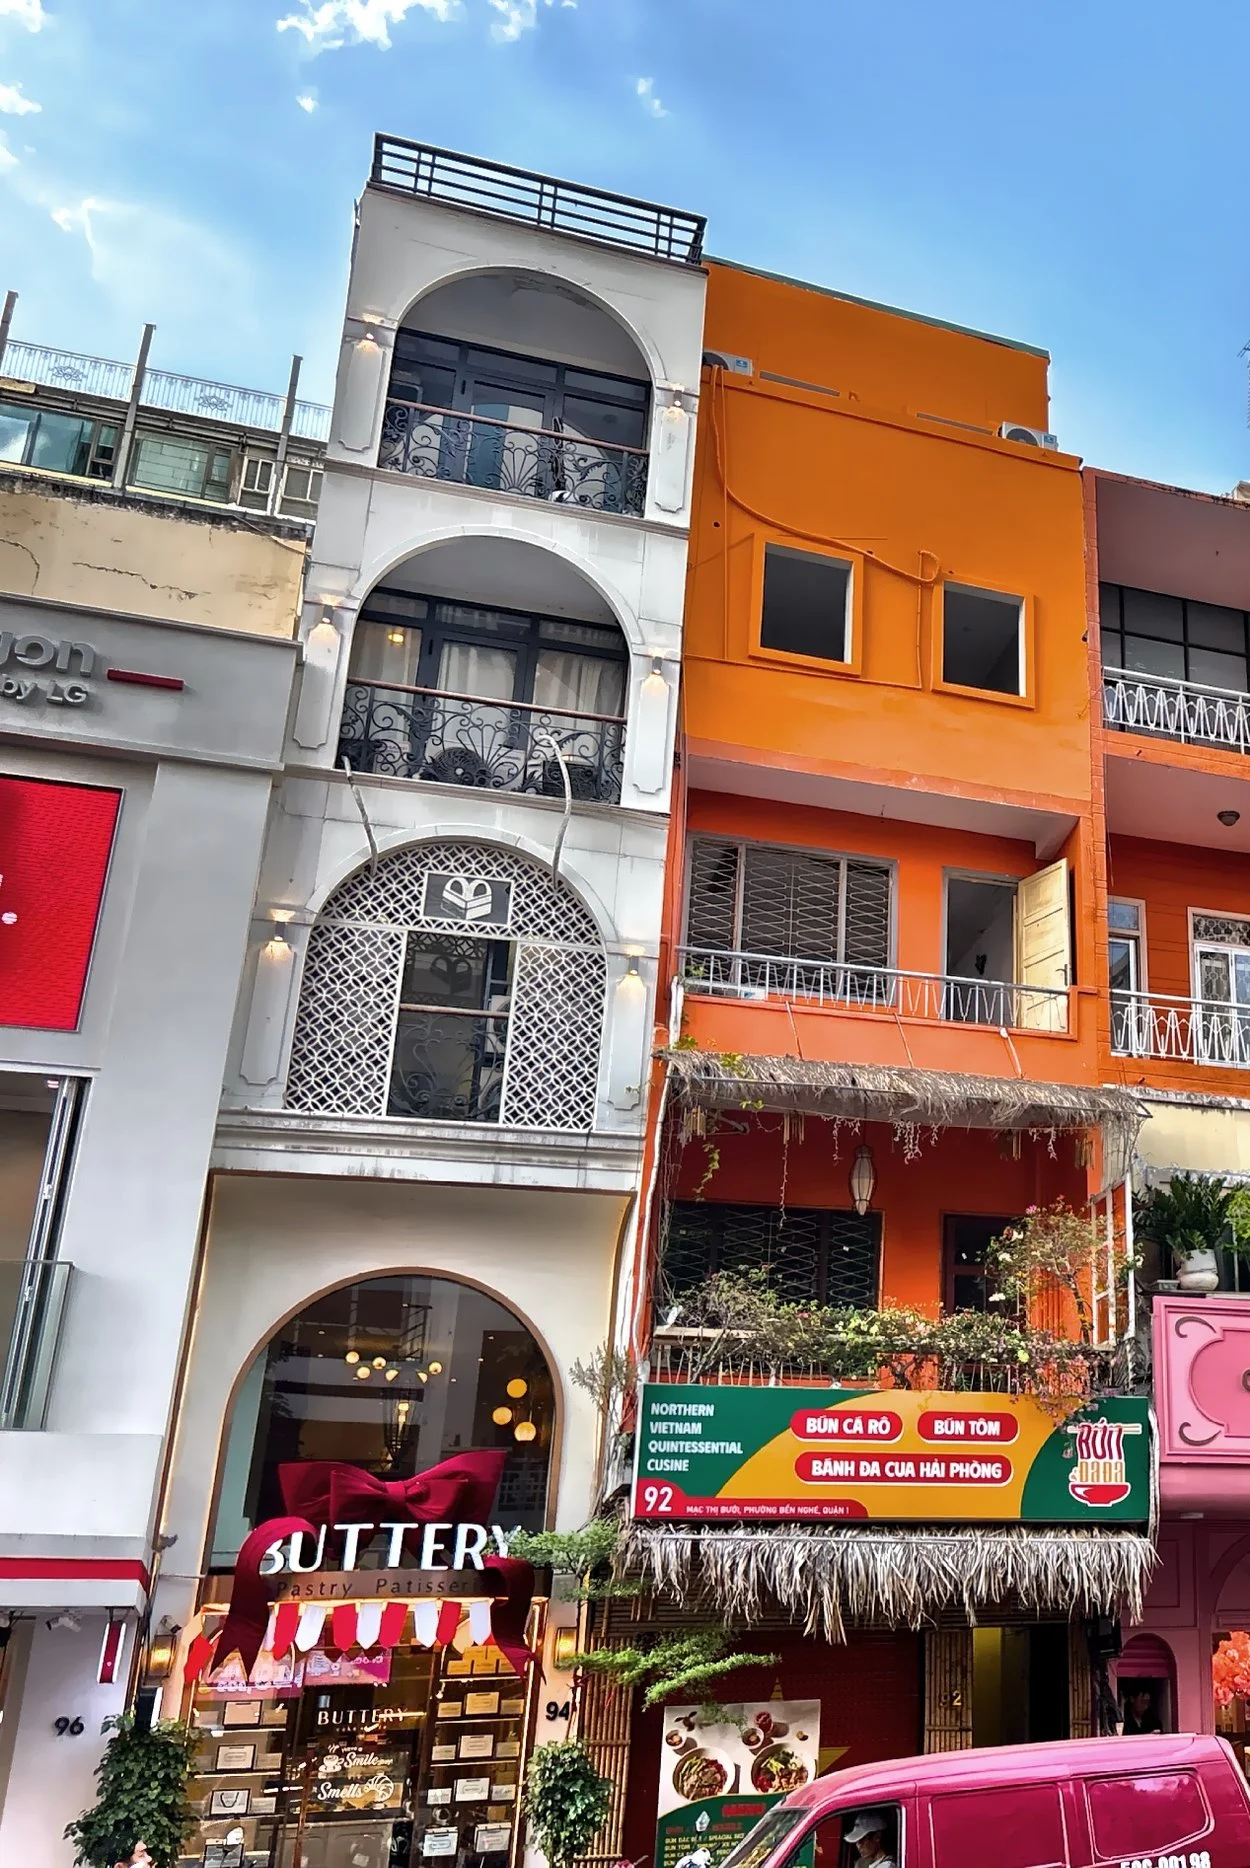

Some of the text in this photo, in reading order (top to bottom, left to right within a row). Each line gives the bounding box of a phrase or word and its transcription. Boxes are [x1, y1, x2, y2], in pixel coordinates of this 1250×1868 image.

[46, 680, 89, 705] LG
[651, 1403, 714, 1417] NORTHERN
[650, 1422, 702, 1435] VIETNAM
[806, 1415, 891, 1434] BÚN CÁ RÔ
[933, 1417, 1000, 1436] BÚN TÔM
[648, 1441, 743, 1455] QUINTESSENTIAL
[647, 1459, 689, 1472] CUSINE
[811, 1458, 1002, 1479] BÁNH ĐA CUA HẢI PHÒNG
[644, 1486, 673, 1513] 92
[846, 1506, 849, 1514] 1
[276, 1582, 353, 1597] Pastry
[317, 1708, 407, 1725] BUTTERY
[546, 1701, 570, 1721] 94
[54, 1716, 85, 1736] 96
[344, 1752, 379, 1767] Smile
[317, 1782, 363, 1801] Smells
